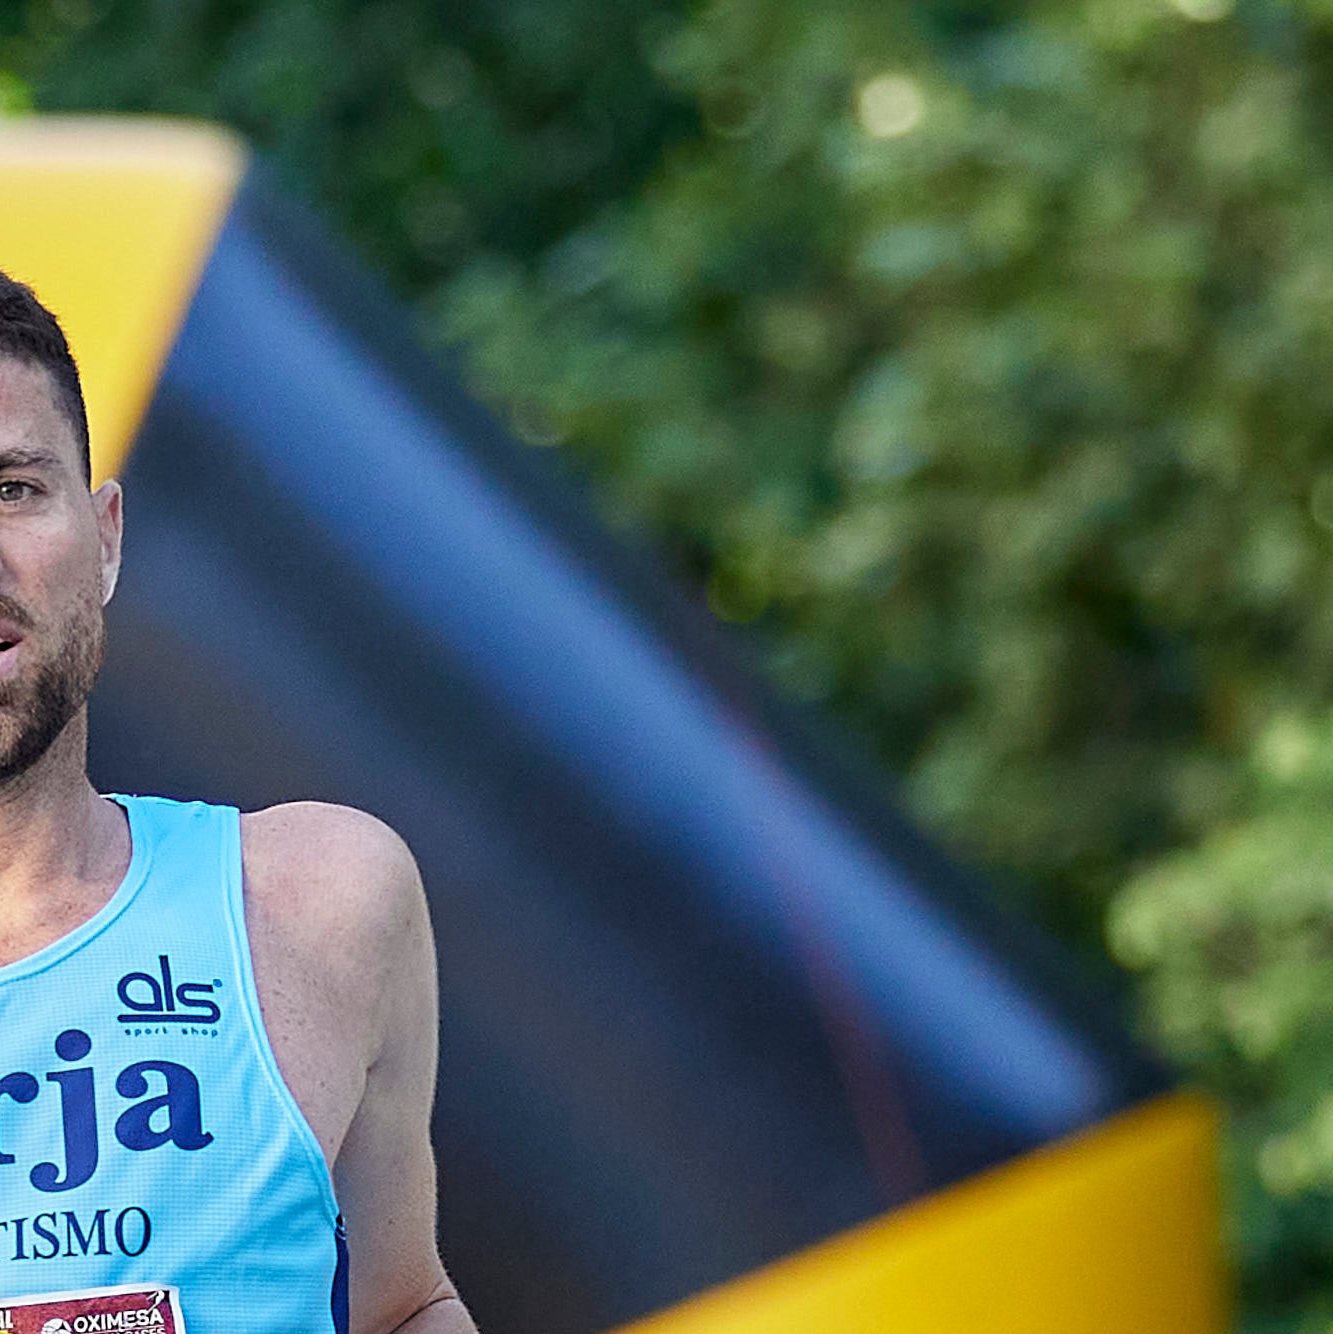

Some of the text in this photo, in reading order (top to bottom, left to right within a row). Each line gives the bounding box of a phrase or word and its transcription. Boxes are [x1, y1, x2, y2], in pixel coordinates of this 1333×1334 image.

[117, 955, 220, 1024] als
[124, 1027, 219, 1039] sport shop
[73, 1308, 165, 1334] OXIMESA
